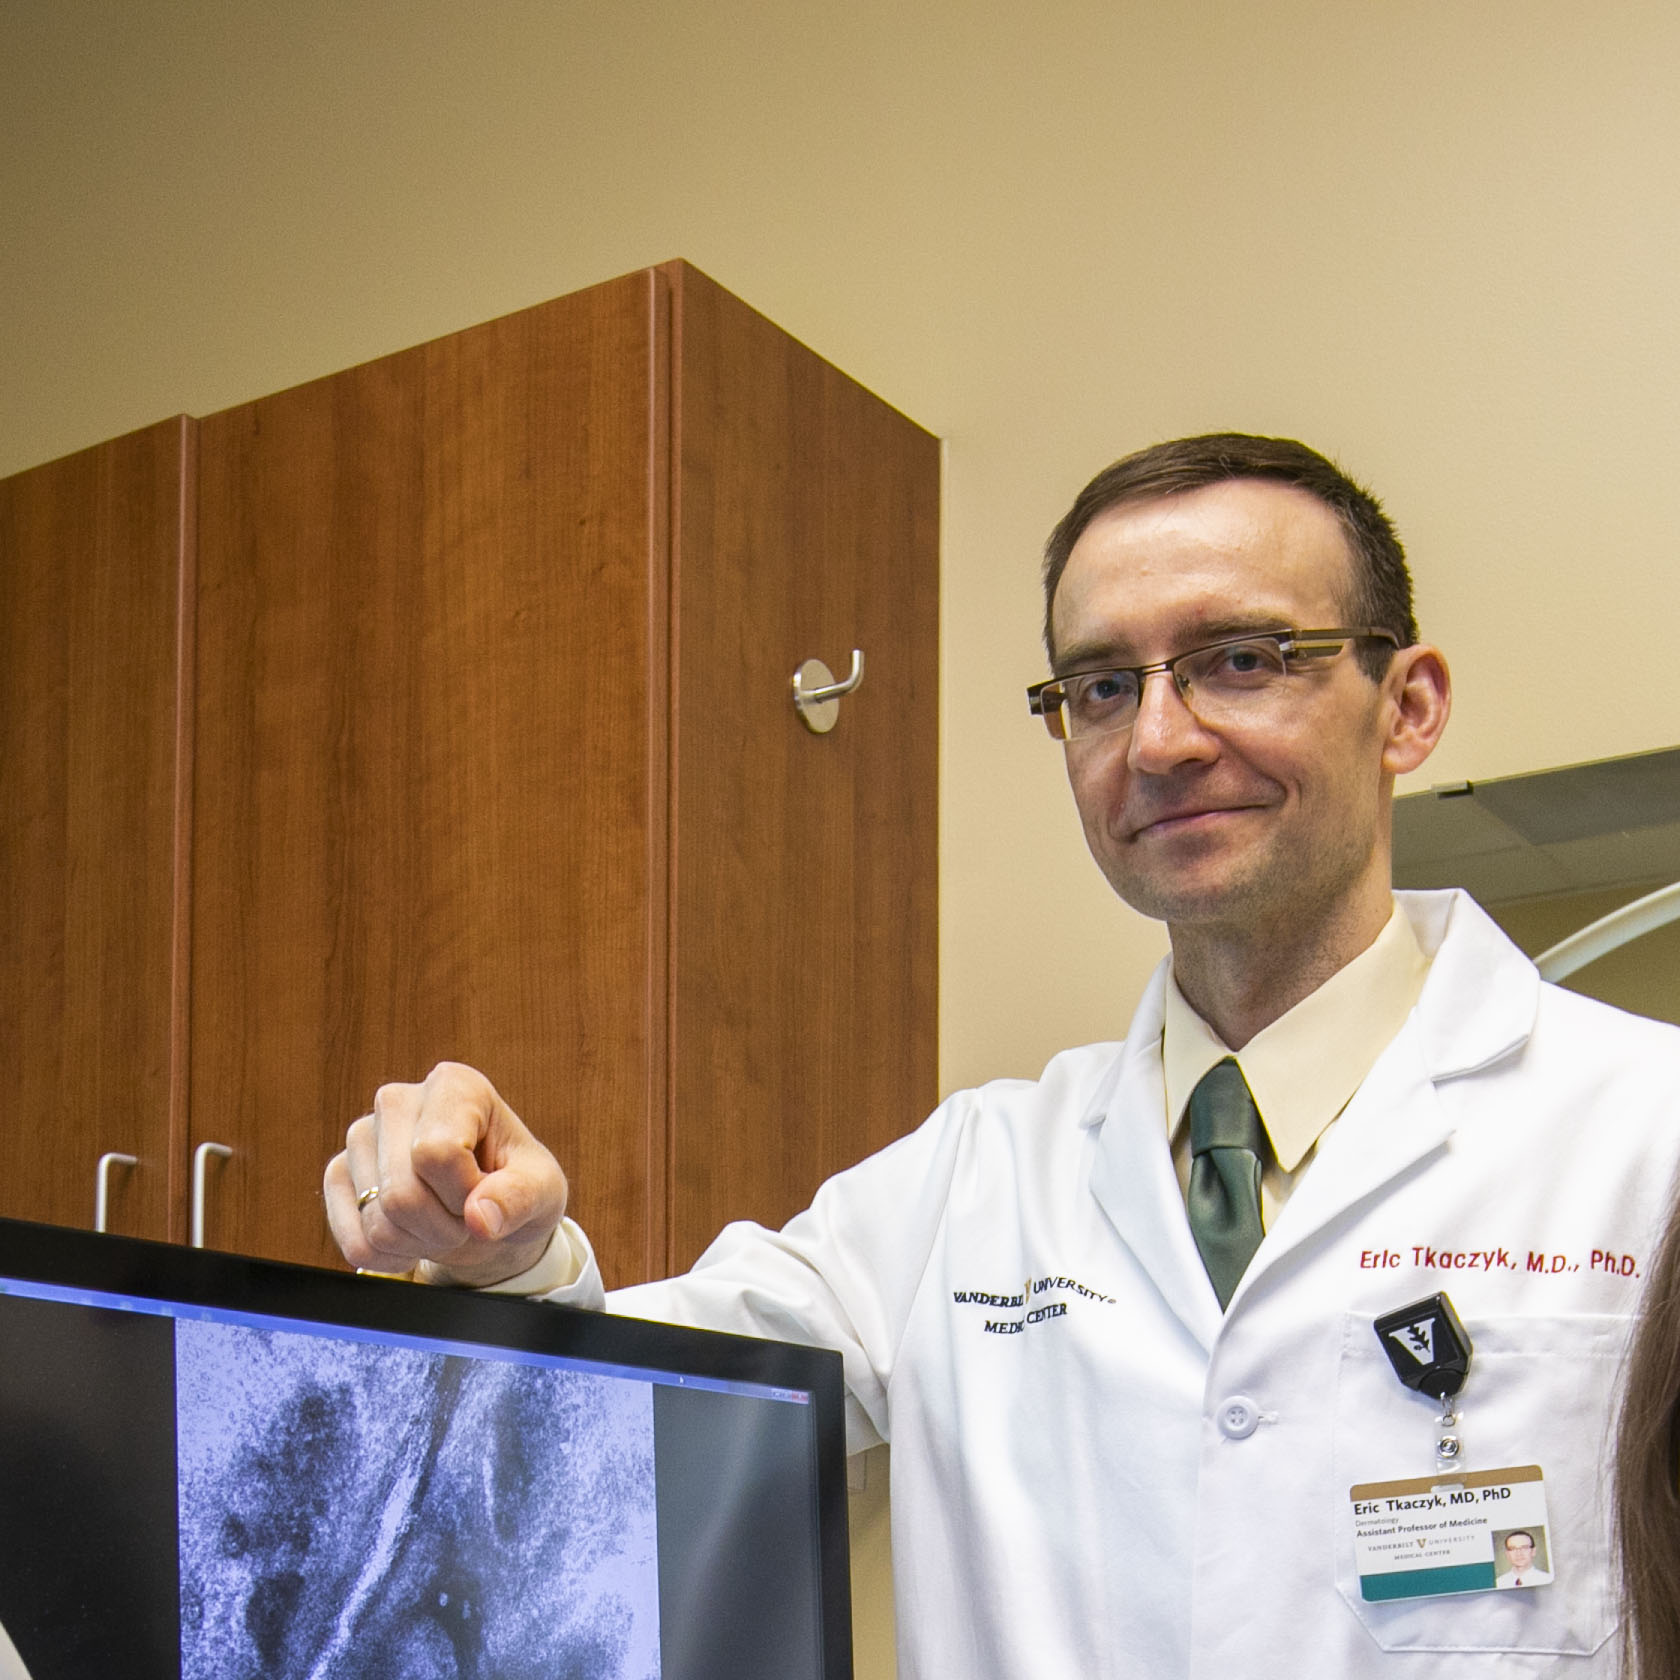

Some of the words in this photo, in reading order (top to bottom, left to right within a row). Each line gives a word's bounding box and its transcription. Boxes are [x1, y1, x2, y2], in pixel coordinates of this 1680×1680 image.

[1360, 1249, 1401, 1268] Eric
[1412, 1247, 1517, 1271] Tkaczyk,
[1527, 1251, 1580, 1273] M.D.,
[1590, 1250, 1640, 1278] Ph.D.
[1026, 1301, 1067, 1324] CENTER
[1354, 1502, 1380, 1515] Eric
[1386, 1494, 1447, 1511] Tkaczyk,
[1450, 1491, 1480, 1505] MD,
[1482, 1487, 1511, 1501] PhD
[1355, 1518, 1399, 1527] Dermatology
[1357, 1527, 1396, 1537] Assistant
[1398, 1524, 1437, 1533] Professor
[1449, 1518, 1488, 1527] Medicine
[1368, 1541, 1414, 1551] VANDERBILT
[1429, 1535, 1475, 1545] UNIVERSITY
[1394, 1552, 1422, 1560] MEDICAL
[1424, 1549, 1451, 1557] CENTER
